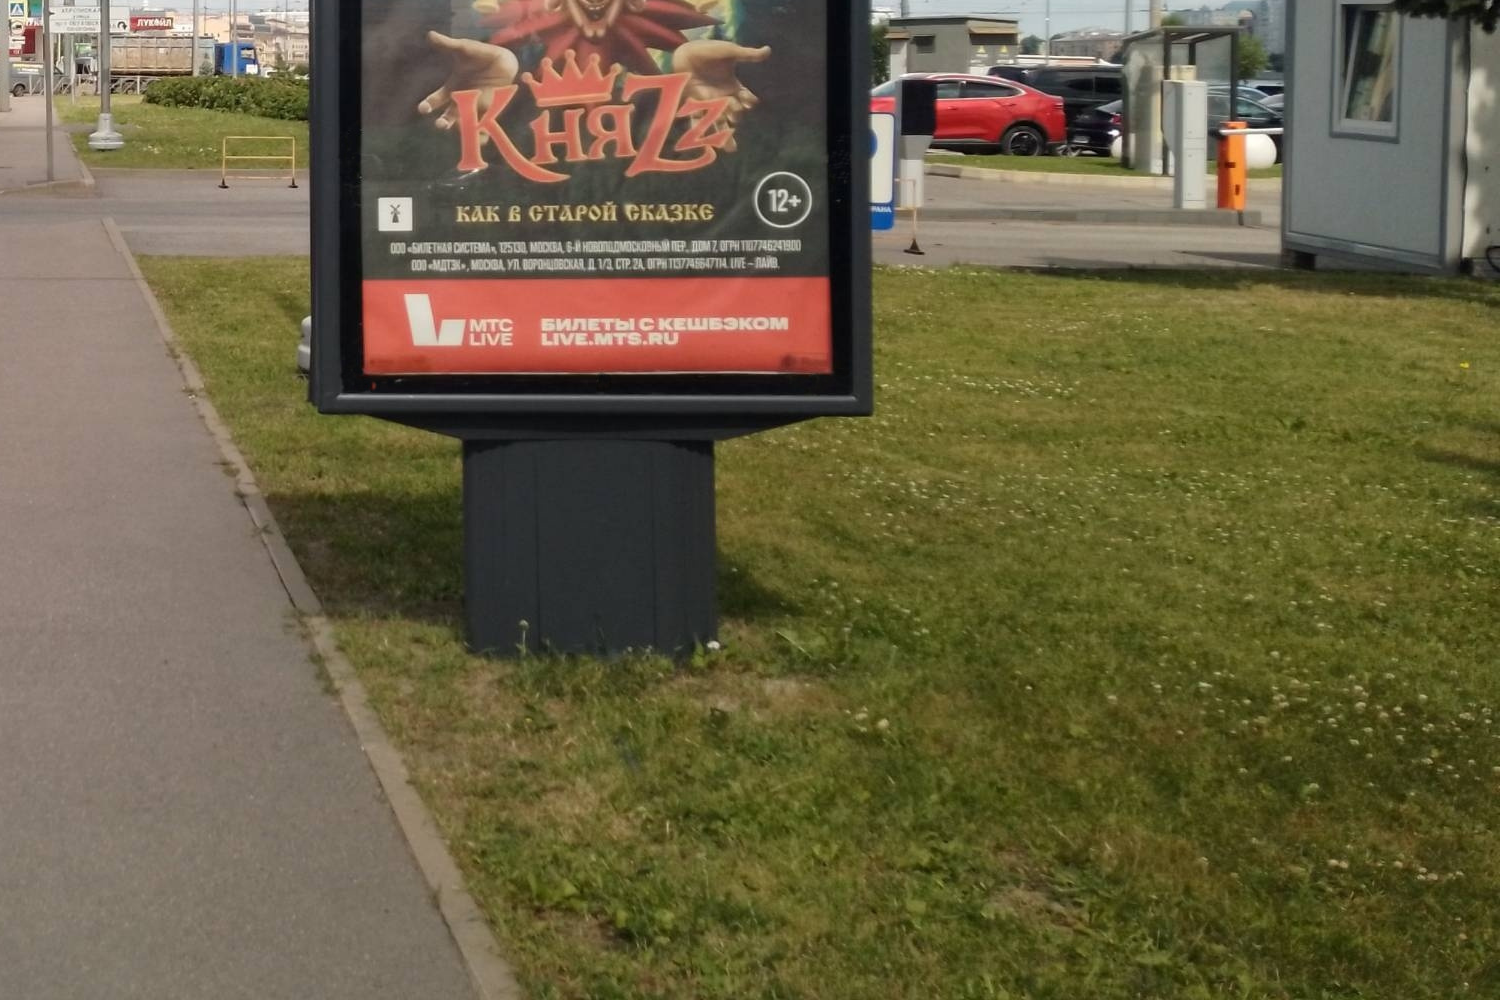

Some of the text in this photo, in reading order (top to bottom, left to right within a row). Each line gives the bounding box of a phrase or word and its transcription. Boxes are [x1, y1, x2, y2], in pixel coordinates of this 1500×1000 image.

[137, 17, 172, 27] ЛУКОЙЛ
[767, 189, 801, 213] 12+
[455, 201, 714, 223] КАК В СТАРОЙ СКАЗКЕ
[469, 318, 513, 332] МТС
[540, 316, 788, 332] БИЛЕТЫ С КЕШБЭКОМ
[469, 333, 513, 347] LIVE
[540, 332, 679, 347] LIVE.MTS.RU
